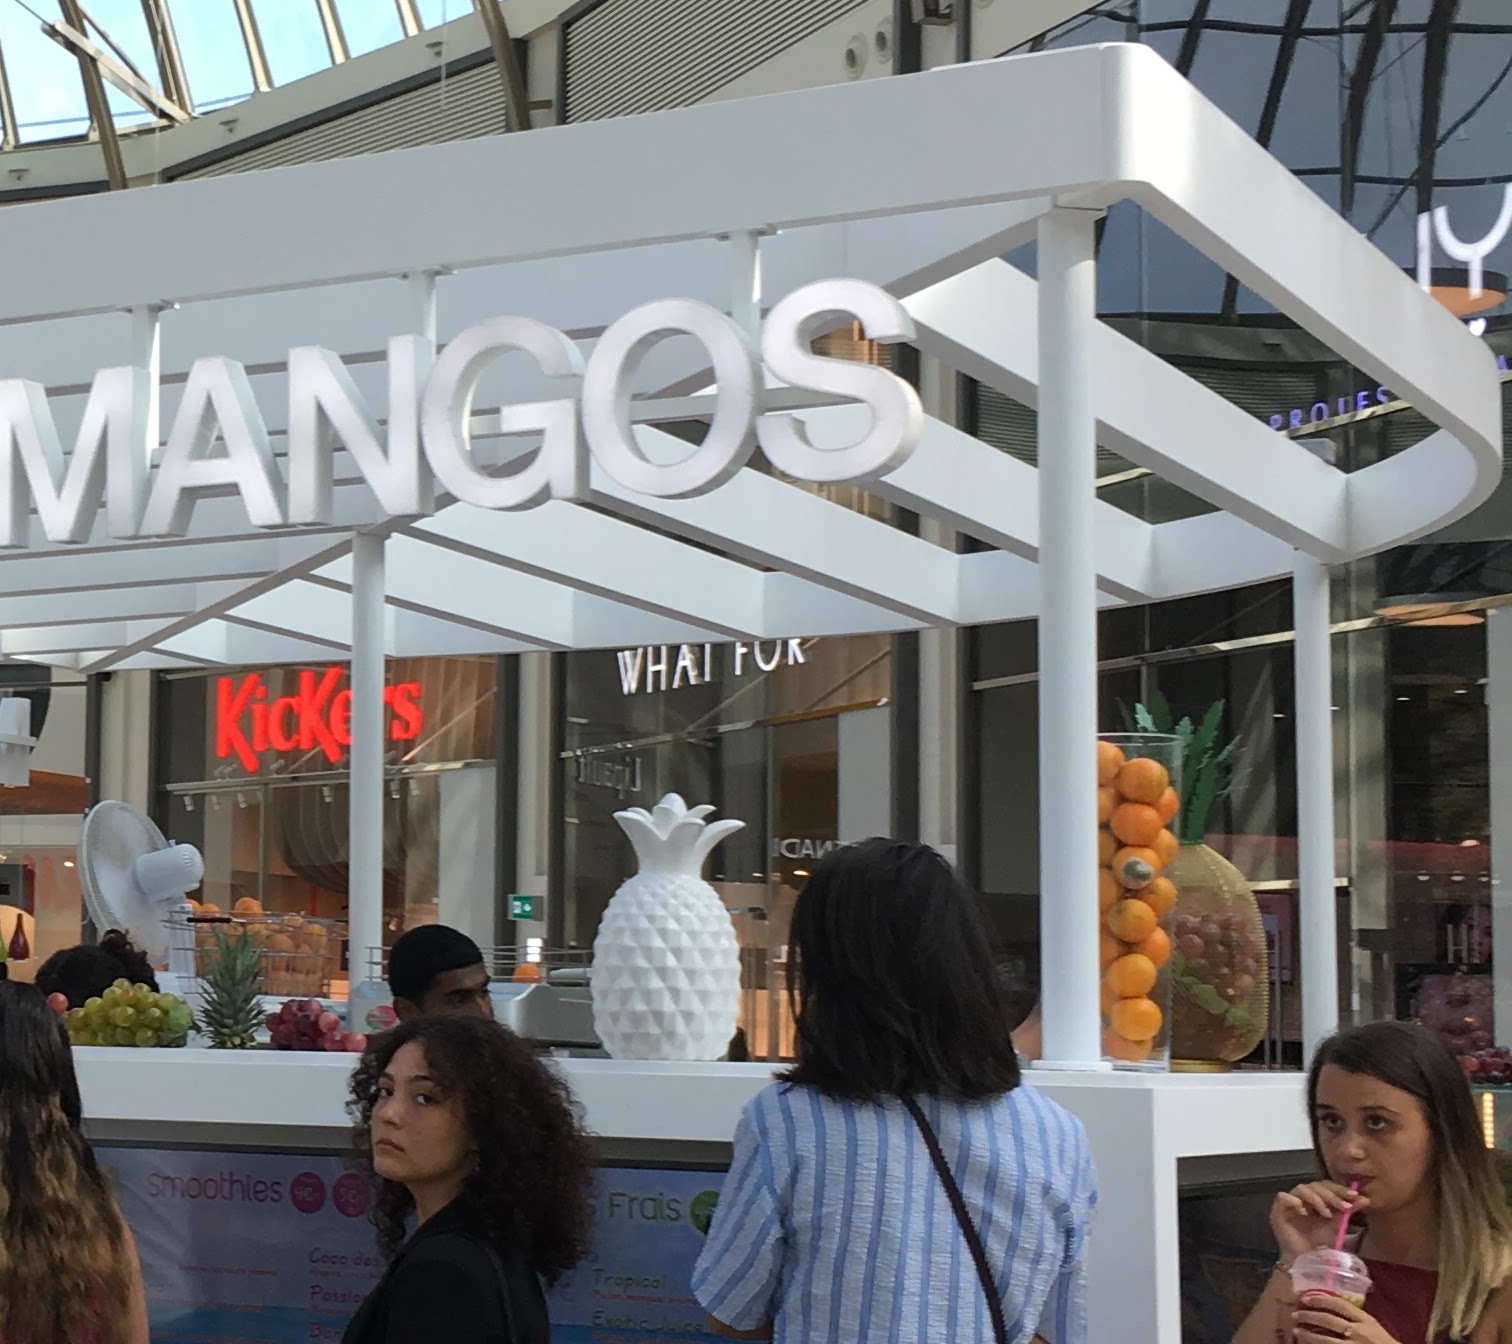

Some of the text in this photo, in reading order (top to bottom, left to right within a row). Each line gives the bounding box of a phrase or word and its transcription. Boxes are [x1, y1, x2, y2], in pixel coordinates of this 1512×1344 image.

[147, 1171, 284, 1203] Smoothies
[607, 1191, 683, 1222] Frais
[592, 1267, 668, 1293] Tropical
